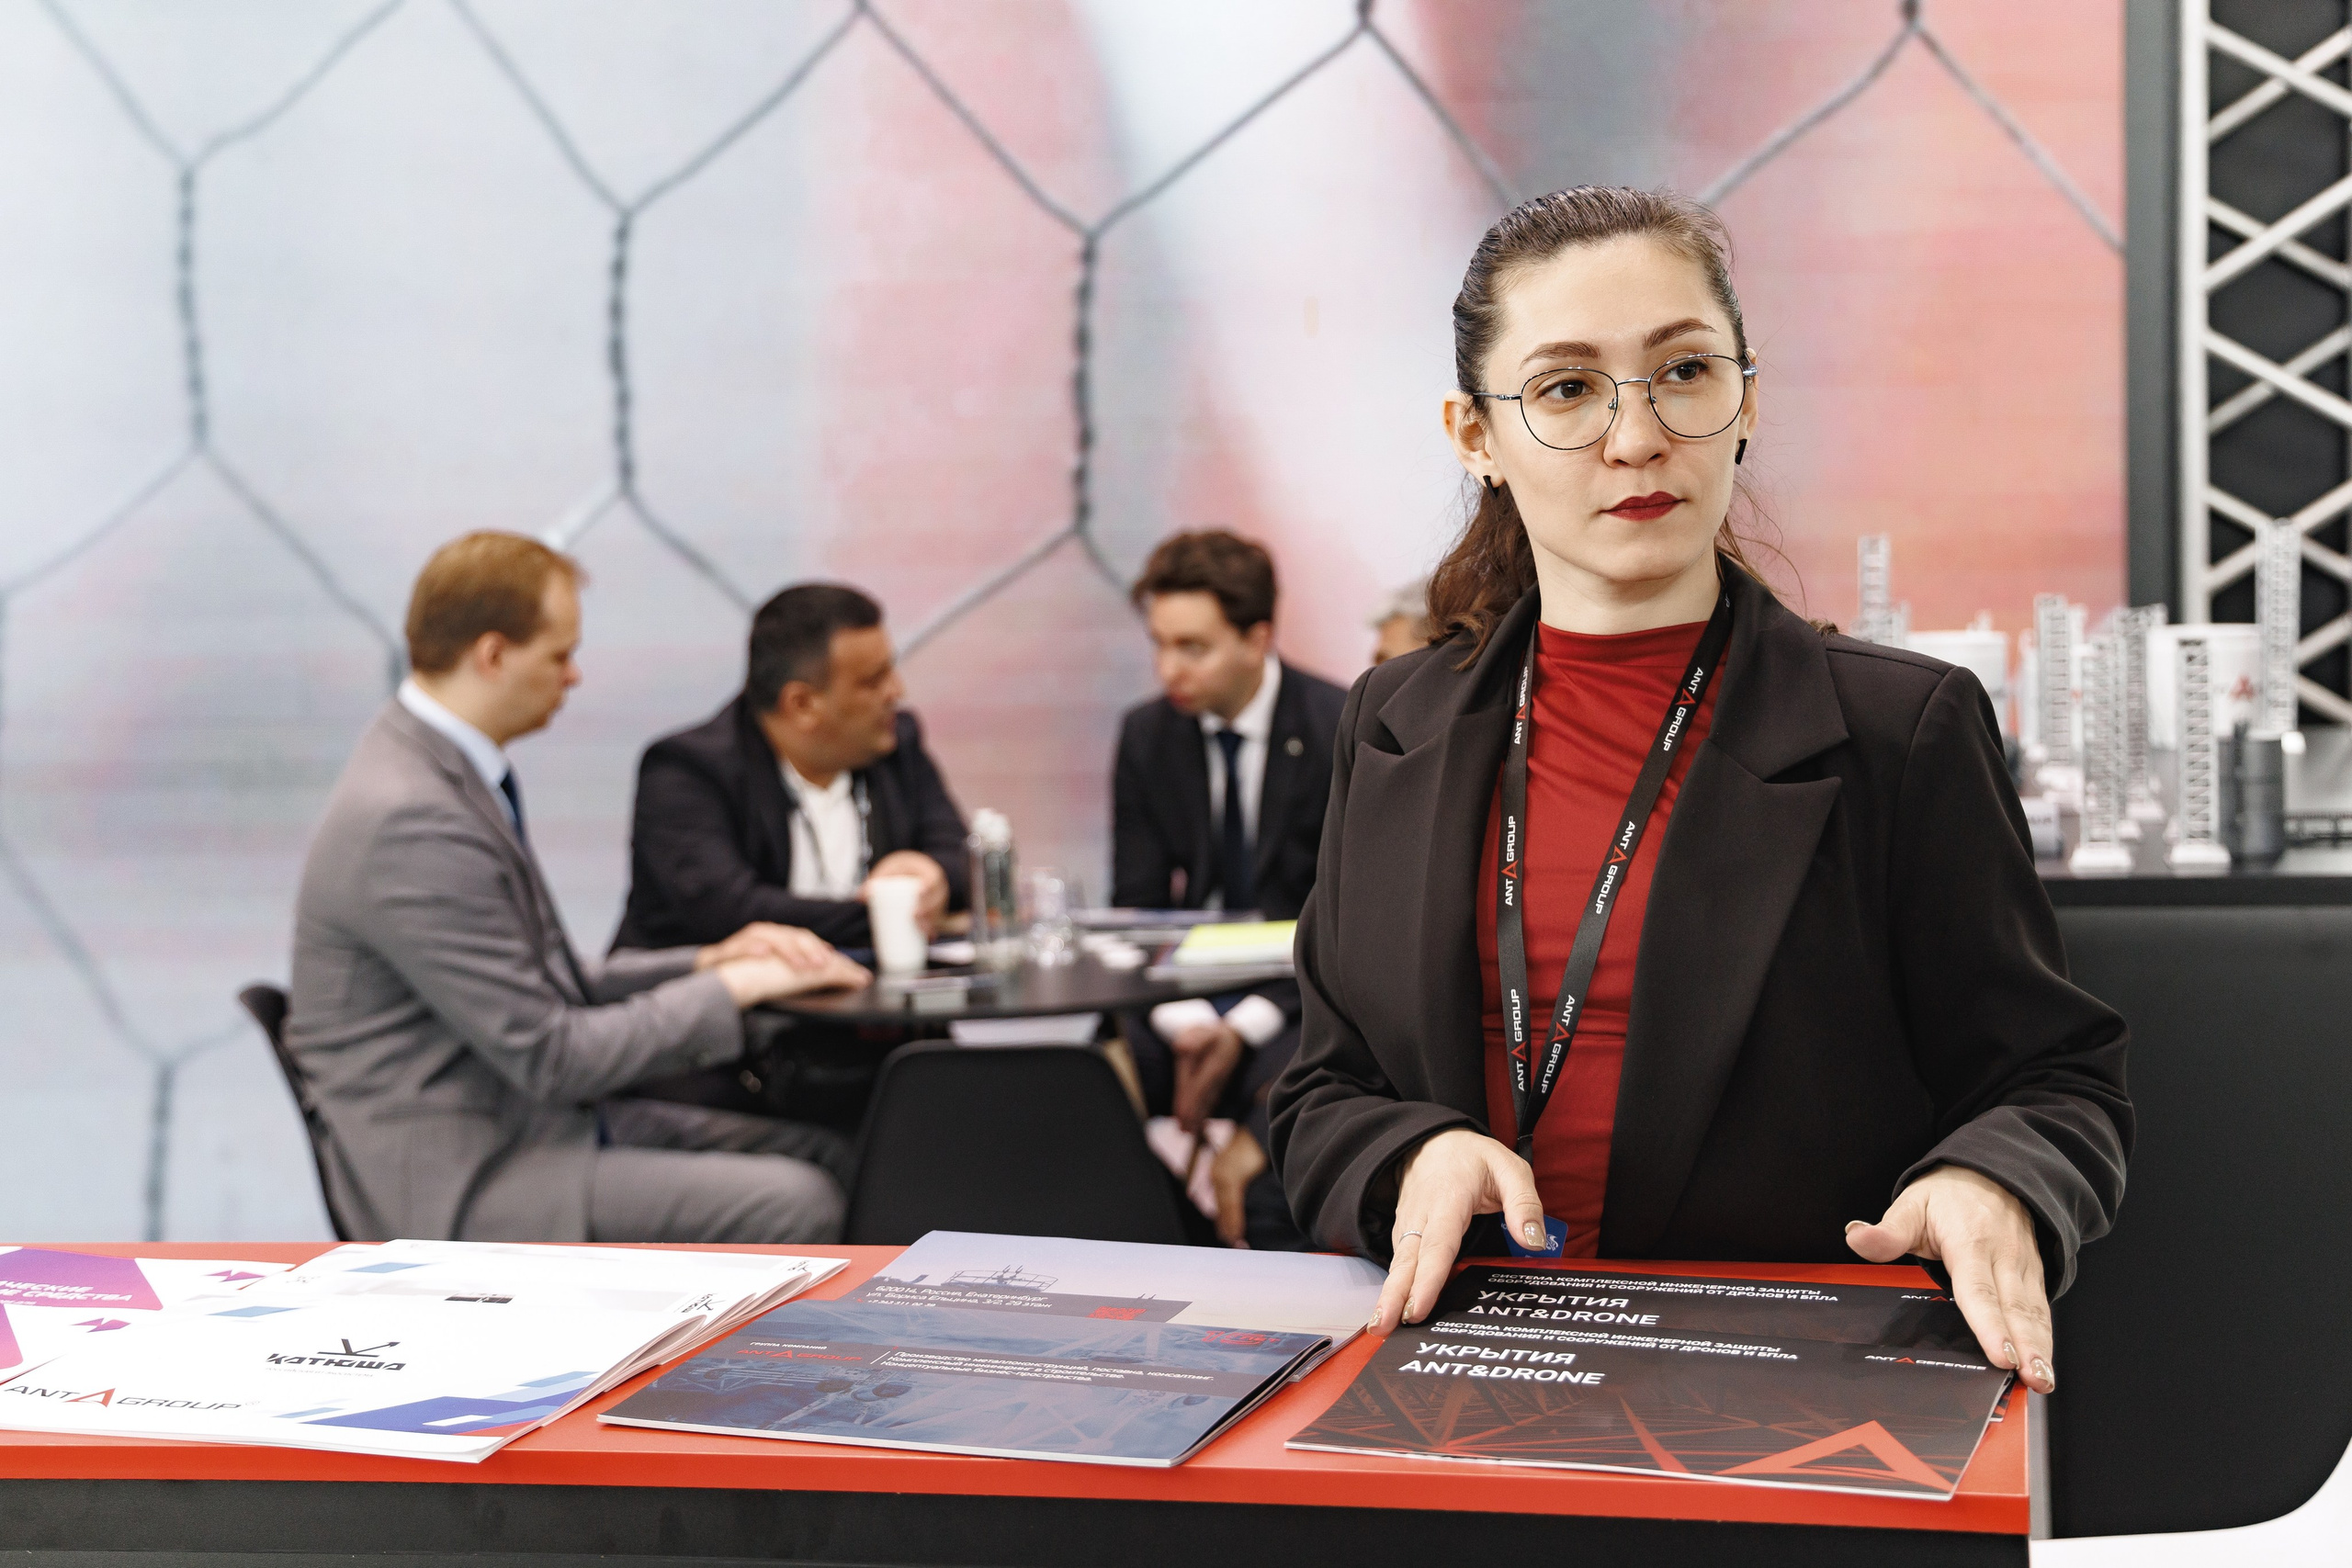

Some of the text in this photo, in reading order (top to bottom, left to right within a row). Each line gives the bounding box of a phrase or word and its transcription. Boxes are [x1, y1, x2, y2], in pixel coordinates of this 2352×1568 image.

[1514, 665, 1529, 745] ANT GROUP
[1663, 667, 1704, 751] ANT GROUP
[1505, 816, 1516, 907] ANT GROUP
[1595, 820, 1635, 914] ANT GROUP
[1510, 989, 1525, 1091] ANT GROUP
[1541, 995, 1576, 1094] ANT GROUP
[1487, 1278, 1594, 1289] ОБОРУДОВАНИЯ
[1609, 1284, 1703, 1294] СООРУЖЕНИЙ
[1725, 1291, 1784, 1299] ДРОНОВ
[1491, 1273, 1821, 1295] СИСТЕМА КОМПЛЕКСНОЙ ИНЖЕНЕРНОЙ ЗАЩИТЫ
[965, 1292, 1048, 1302] Екатеринбург
[1477, 1290, 1630, 1308] УКРЫТИЯ
[1467, 1305, 1660, 1325] ANT&DRONE
[1430, 1326, 1541, 1340] ОБОРУДОВАНИЯ
[1556, 1337, 1656, 1348] СООРУЖЕНИЙ
[1679, 1345, 1742, 1355] ДРОНОВ
[1758, 1351, 1798, 1359] БПЛА
[1435, 1321, 1781, 1352] СИСТЕМА КОМПЛЕКСНОЙ ИНЖЕНЕРНОЙ ЗАЩИТЫ
[797, 1353, 863, 1361] GROUP
[888, 1356, 964, 1366] Комплексный
[894, 1351, 971, 1362] Производство
[1416, 1342, 1577, 1365] УКРЫТИЯ
[1916, 1359, 1986, 1371] DEFENSE
[880, 1360, 972, 1371] Концептуальные
[1398, 1360, 1606, 1384] ANT&DRONE
[4, 1385, 242, 1410] ANT GROUP
